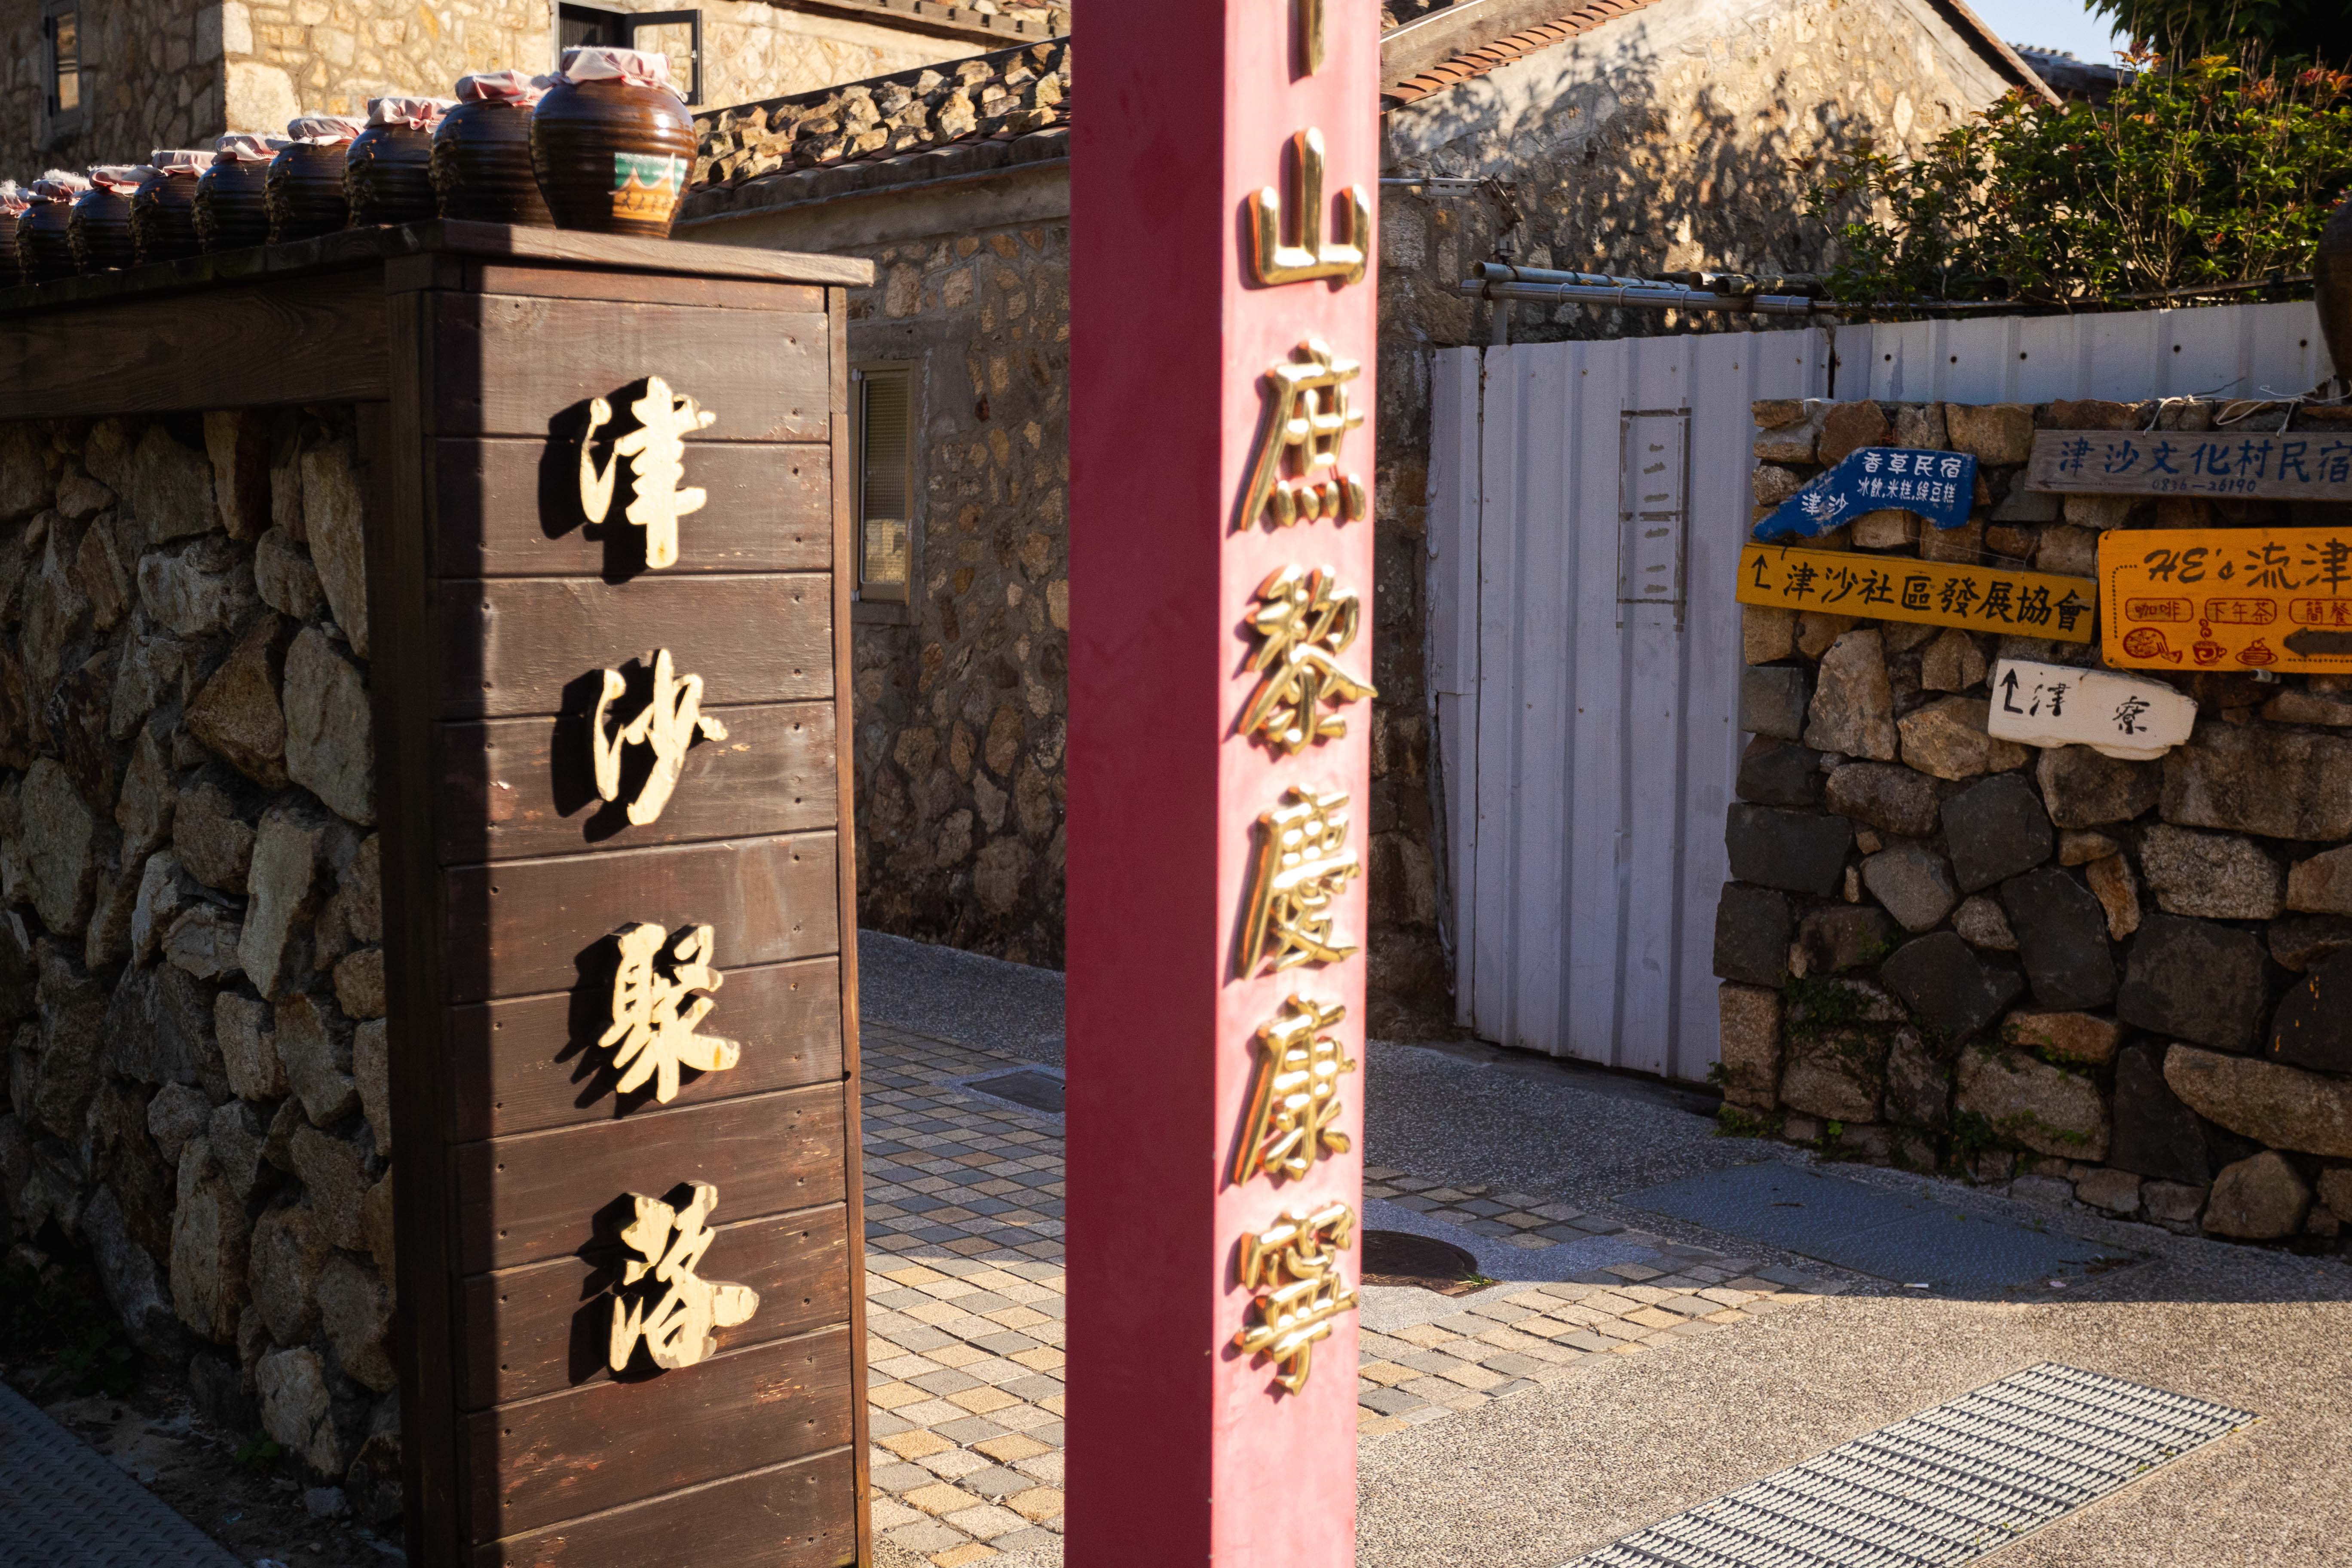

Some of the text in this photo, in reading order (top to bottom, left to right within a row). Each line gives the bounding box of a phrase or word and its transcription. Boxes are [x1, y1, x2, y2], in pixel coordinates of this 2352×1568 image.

[1862, 452, 1962, 478] 香草民宿
[2059, 436, 2352, 484] 津沙文化村民宿
[1801, 492, 1849, 515] 津沙
[1783, 561, 2092, 633] 津沙社區發展協會
[2134, 602, 2181, 619] 咖啡
[2209, 602, 2273, 622] 下午茶
[2306, 602, 2352, 625] 簡餐
[1230, 0, 1378, 1395] 山庶黎慶康寧
[578, 376, 759, 1371] 津沙聚落
